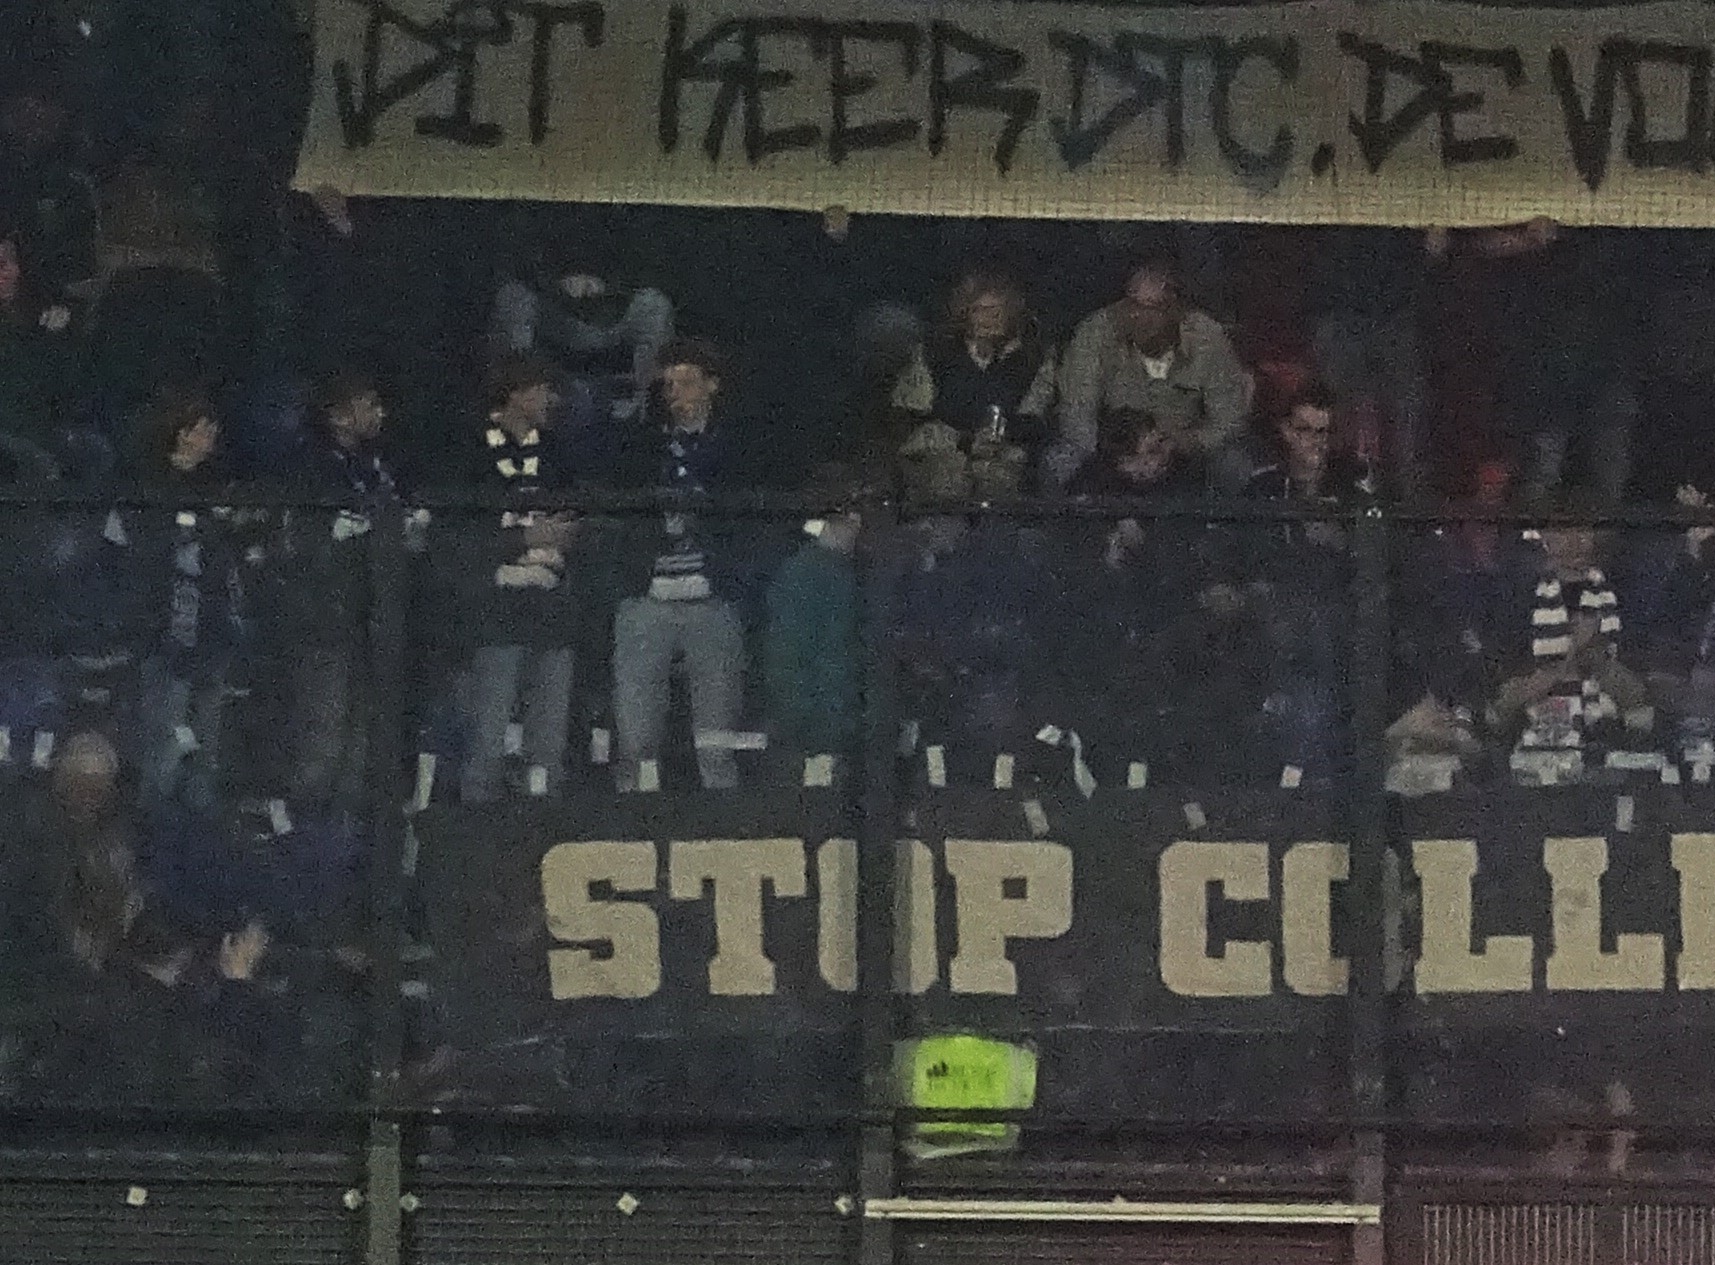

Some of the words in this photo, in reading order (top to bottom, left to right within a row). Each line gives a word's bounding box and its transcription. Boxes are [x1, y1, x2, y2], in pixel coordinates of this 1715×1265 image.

[656, 2, 1040, 176] KEER
[1336, 31, 1524, 174] DE
[541, 837, 1074, 1000] STOP
